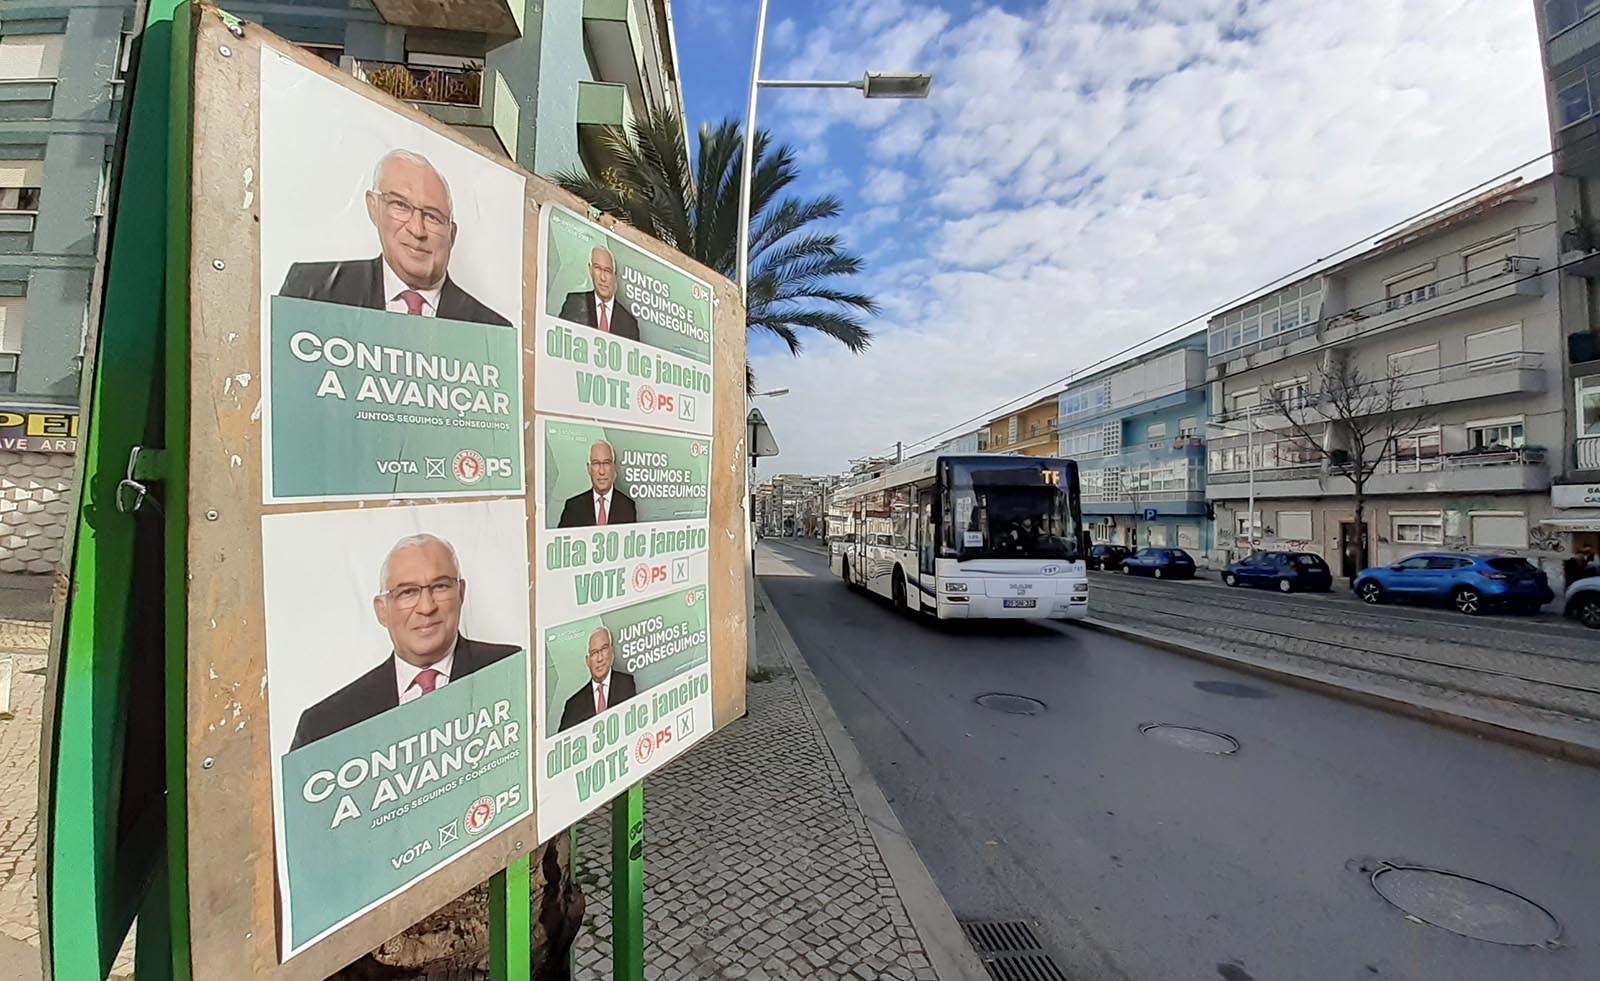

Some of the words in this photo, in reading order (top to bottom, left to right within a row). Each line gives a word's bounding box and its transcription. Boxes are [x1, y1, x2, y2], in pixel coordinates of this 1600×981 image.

[622, 265, 670, 298] JUNTOS
[626, 284, 686, 318] SEGUIMOS
[686, 308, 694, 322] E
[630, 303, 710, 344] CONSEGUIMOS
[289, 330, 500, 389] CONTINUAR
[546, 325, 589, 365] dia
[593, 335, 622, 372] 30
[627, 347, 652, 379] de
[655, 355, 711, 394] janeiro
[316, 370, 347, 399] A
[356, 374, 510, 417] AVANÇAR
[576, 371, 631, 410] VOTE
[658, 395, 674, 413] PS
[355, 411, 395, 422] JUNTOS
[396, 414, 444, 426] SEGUIMOS
[445, 418, 452, 426] E
[452, 418, 511, 431] CONSEGUIMOS
[0, 438, 28, 450] VE
[621, 450, 668, 467] JUNTOS
[376, 460, 418, 475] VOTA
[486, 457, 512, 477] PS
[625, 468, 682, 483] SEGUIMOS
[684, 470, 691, 483] E
[629, 484, 707, 499] CONSEGUIMOS
[546, 536, 587, 570] dia
[592, 531, 620, 564] 30
[623, 530, 647, 558] de
[649, 525, 707, 558] janeiro
[574, 567, 626, 606] VOTE
[651, 565, 667, 583] PS
[617, 615, 664, 644] JUNTOS
[622, 627, 680, 659] SEGUIMOS
[681, 622, 688, 636] E
[627, 631, 706, 673] CONSEGUIMOS
[546, 735, 588, 779] dia
[592, 712, 620, 751] 30
[624, 703, 649, 735] de
[652, 672, 709, 725] janeiro
[302, 698, 511, 804] CONTINUAR
[576, 745, 629, 803] VOTE
[655, 726, 672, 749] PS
[329, 796, 361, 829] A
[370, 721, 520, 812] AVANÇAR
[370, 804, 410, 829] JUNTOS
[411, 781, 458, 810] SEGUIMOS
[458, 776, 465, 786] E
[464, 750, 521, 782] CONSEGUIMOS
[391, 841, 432, 870] VOTA
[495, 784, 521, 814] PS
